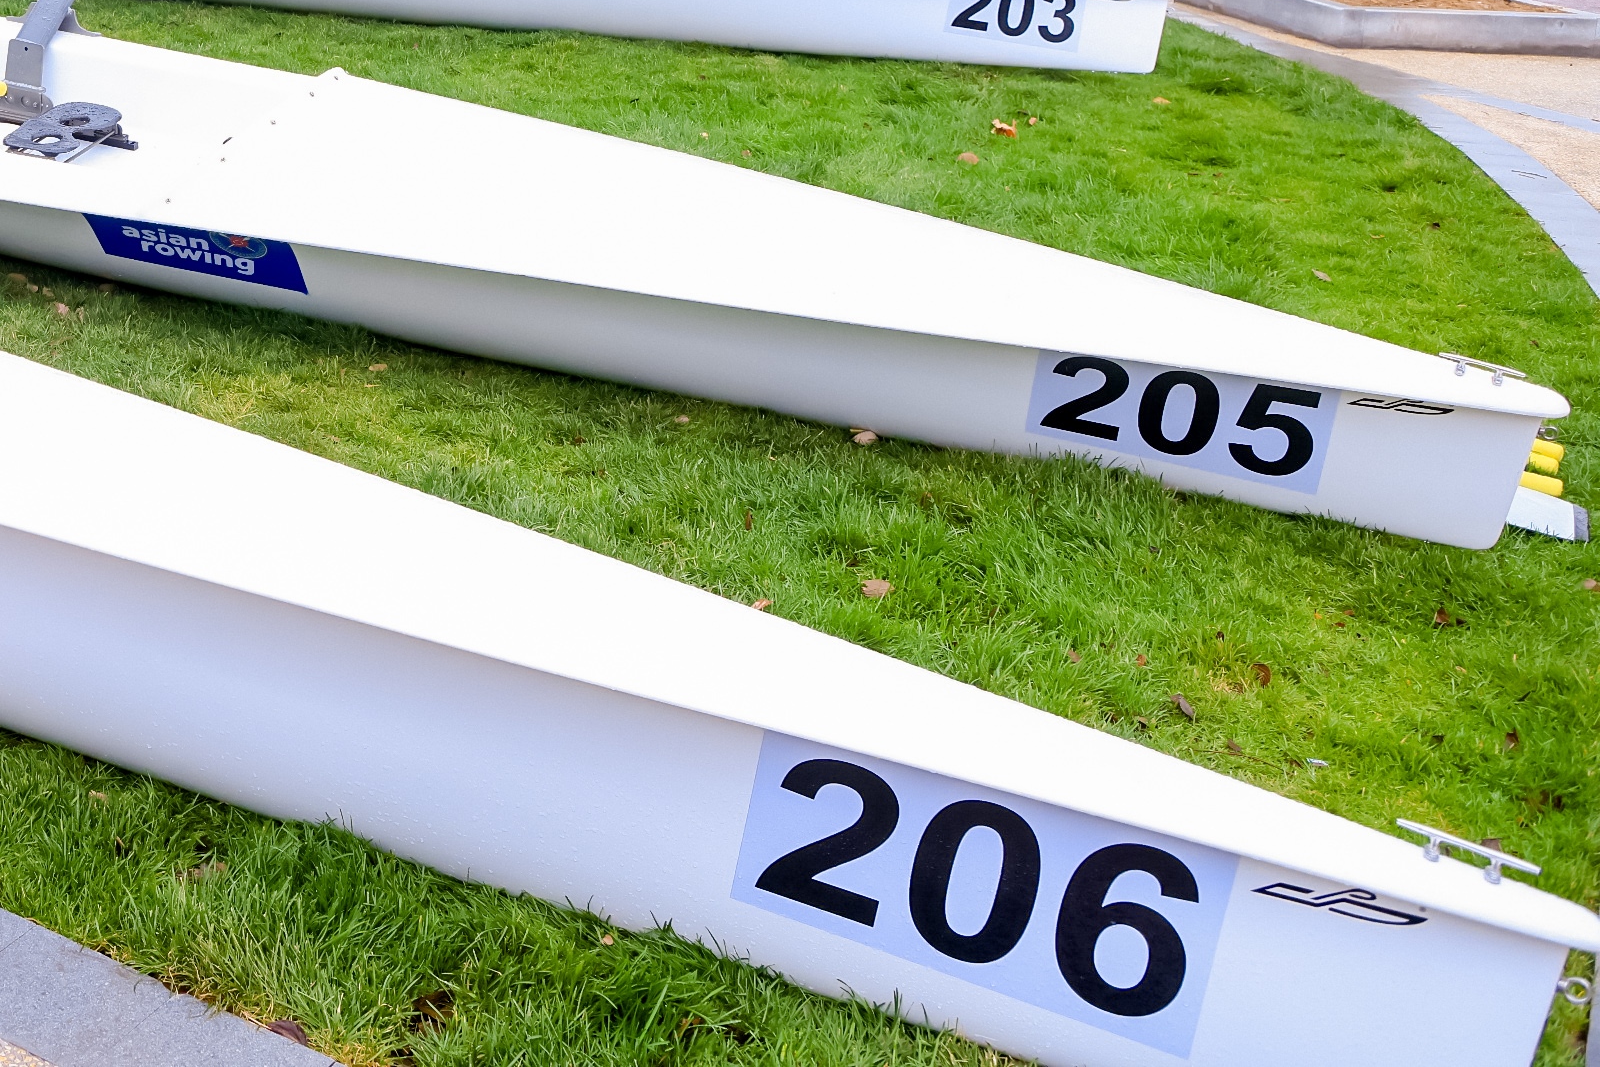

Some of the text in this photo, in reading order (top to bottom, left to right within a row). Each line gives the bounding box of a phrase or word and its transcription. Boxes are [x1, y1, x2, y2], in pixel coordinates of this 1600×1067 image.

[121, 225, 209, 251] asian
[140, 240, 255, 276] rowing
[1039, 355, 1323, 477] 205
[755, 758, 1201, 1018] 206
